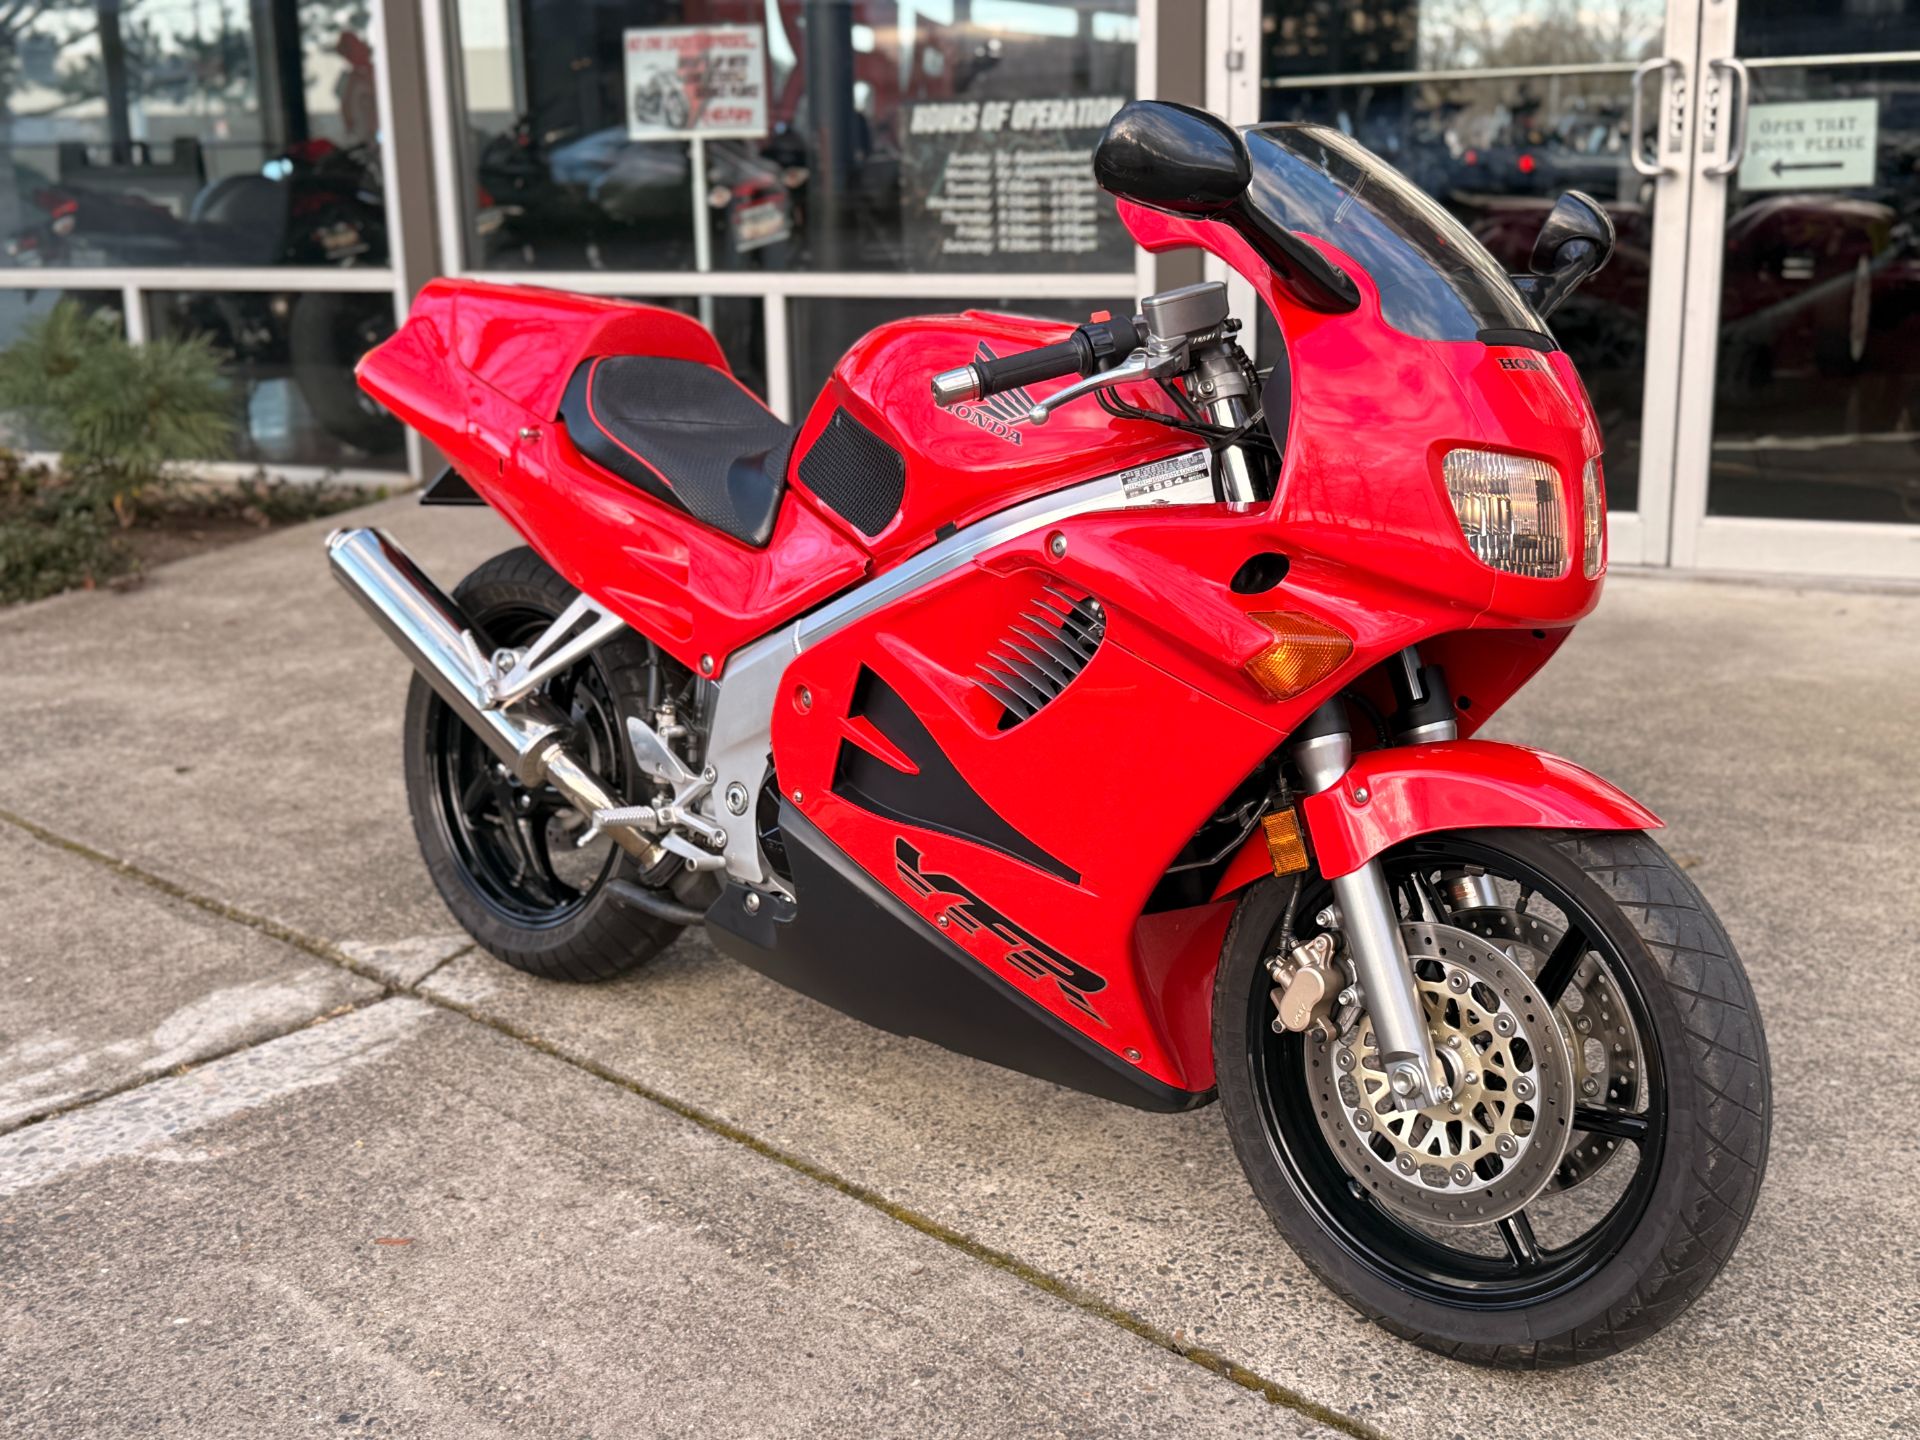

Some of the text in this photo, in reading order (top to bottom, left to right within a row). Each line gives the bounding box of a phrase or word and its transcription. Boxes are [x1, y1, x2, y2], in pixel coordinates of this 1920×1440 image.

[910, 103, 980, 134] HOURS
[980, 101, 1010, 131] OF
[1759, 115, 1858, 134] OPEN THAT
[1804, 134, 1866, 152] PLEASE
[1497, 358, 1556, 374] HON
[895, 835, 1112, 1029] VFR
